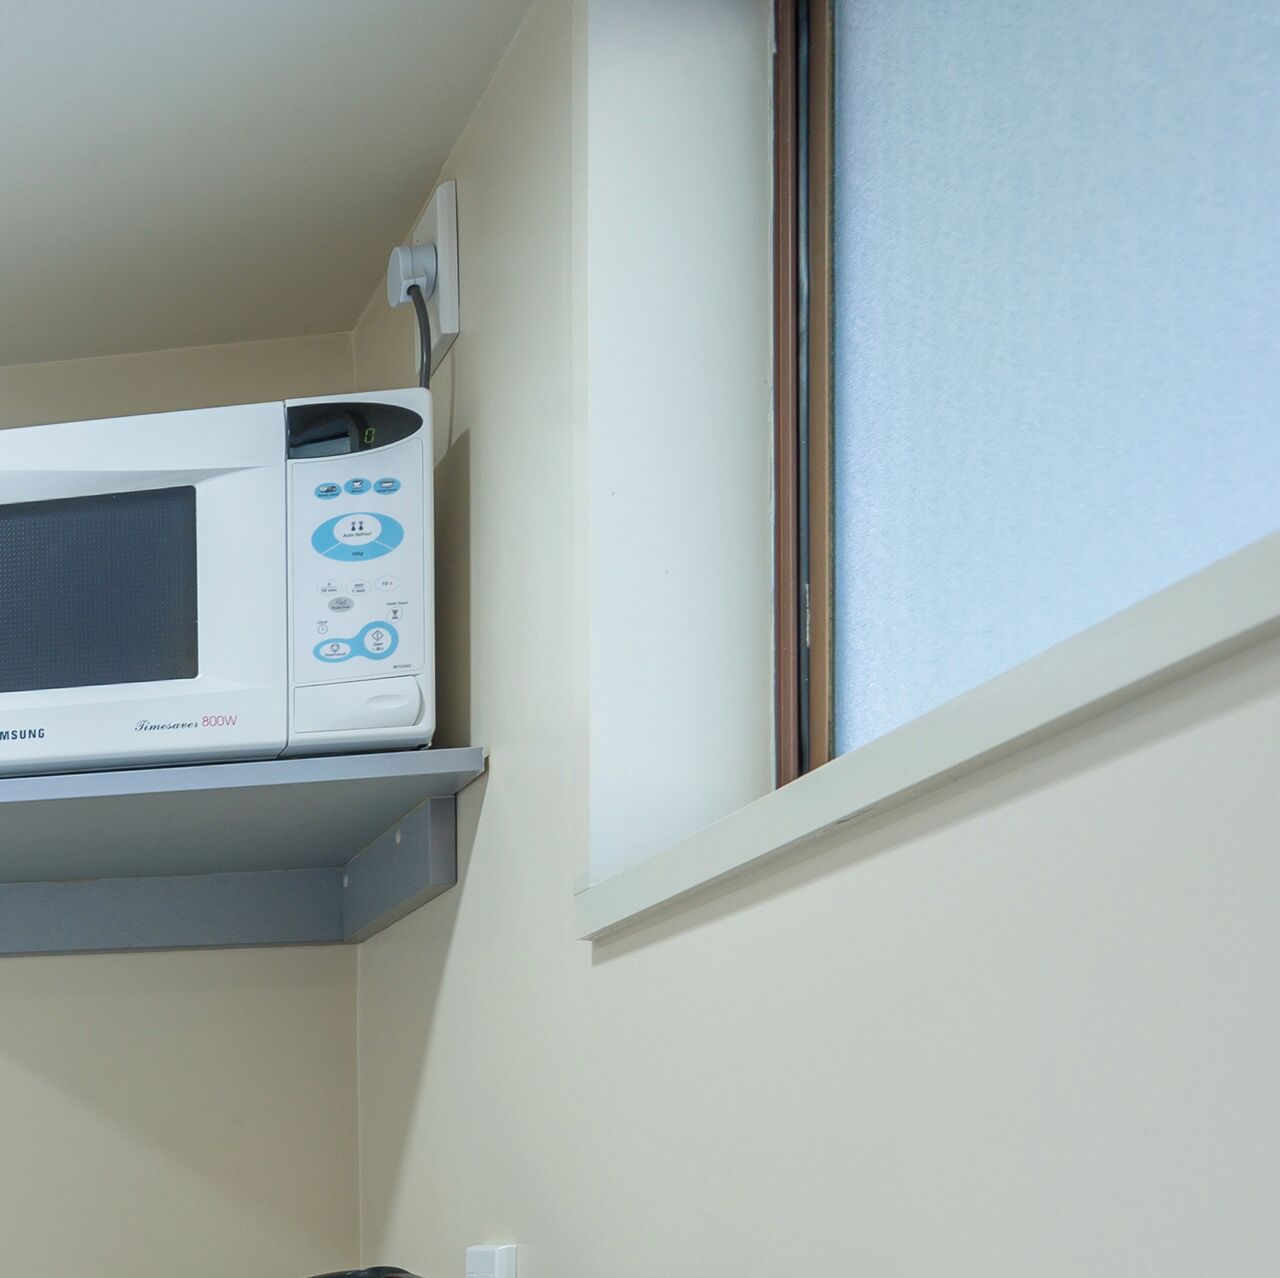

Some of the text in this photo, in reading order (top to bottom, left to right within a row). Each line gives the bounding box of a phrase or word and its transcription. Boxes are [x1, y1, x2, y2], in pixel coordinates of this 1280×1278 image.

[364, 427, 375, 444] 0
[134, 714, 238, 732] Timesaver 800W
